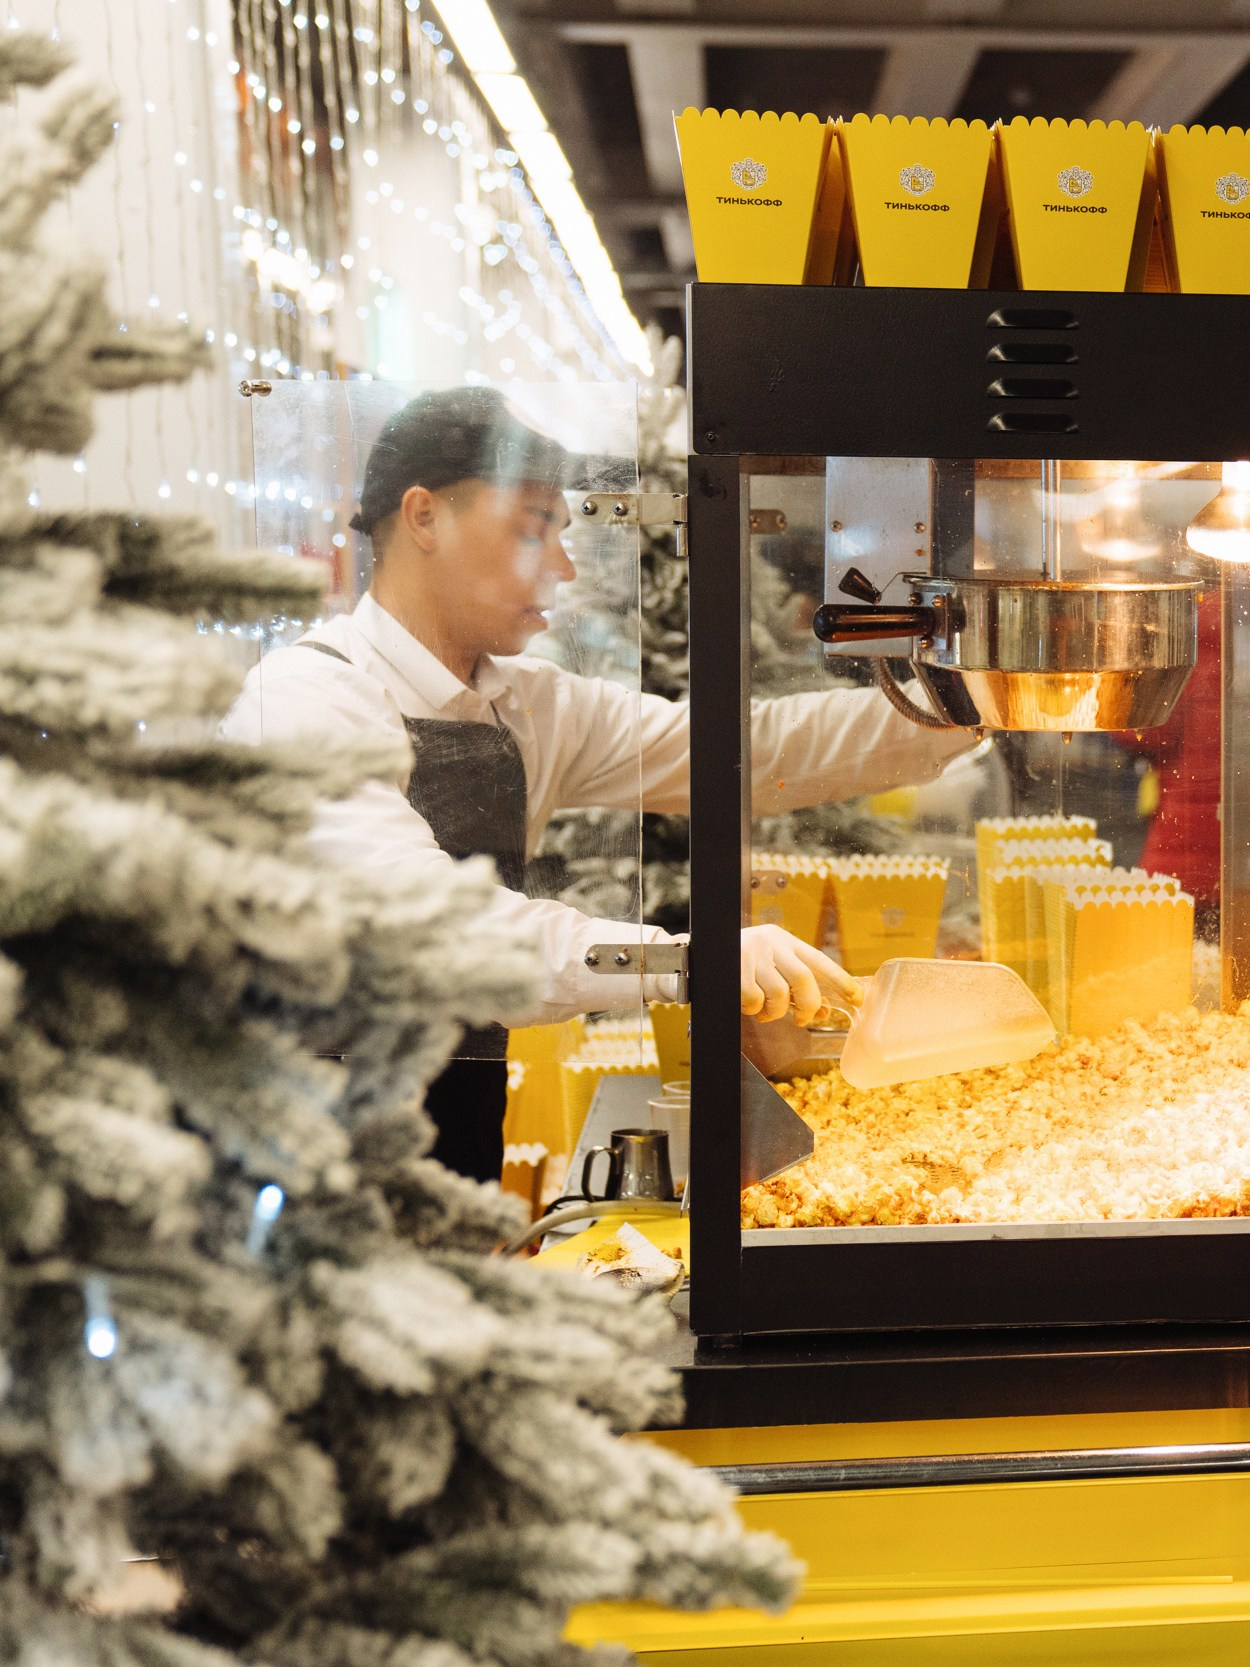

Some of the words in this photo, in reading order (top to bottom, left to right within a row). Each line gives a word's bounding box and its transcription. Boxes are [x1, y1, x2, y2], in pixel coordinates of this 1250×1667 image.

[716, 196, 783, 207] ТИНЬКОФФ
[884, 201, 950, 212] ТИНЬКОФФ
[1042, 204, 1108, 214] ТИНЬКОФФ
